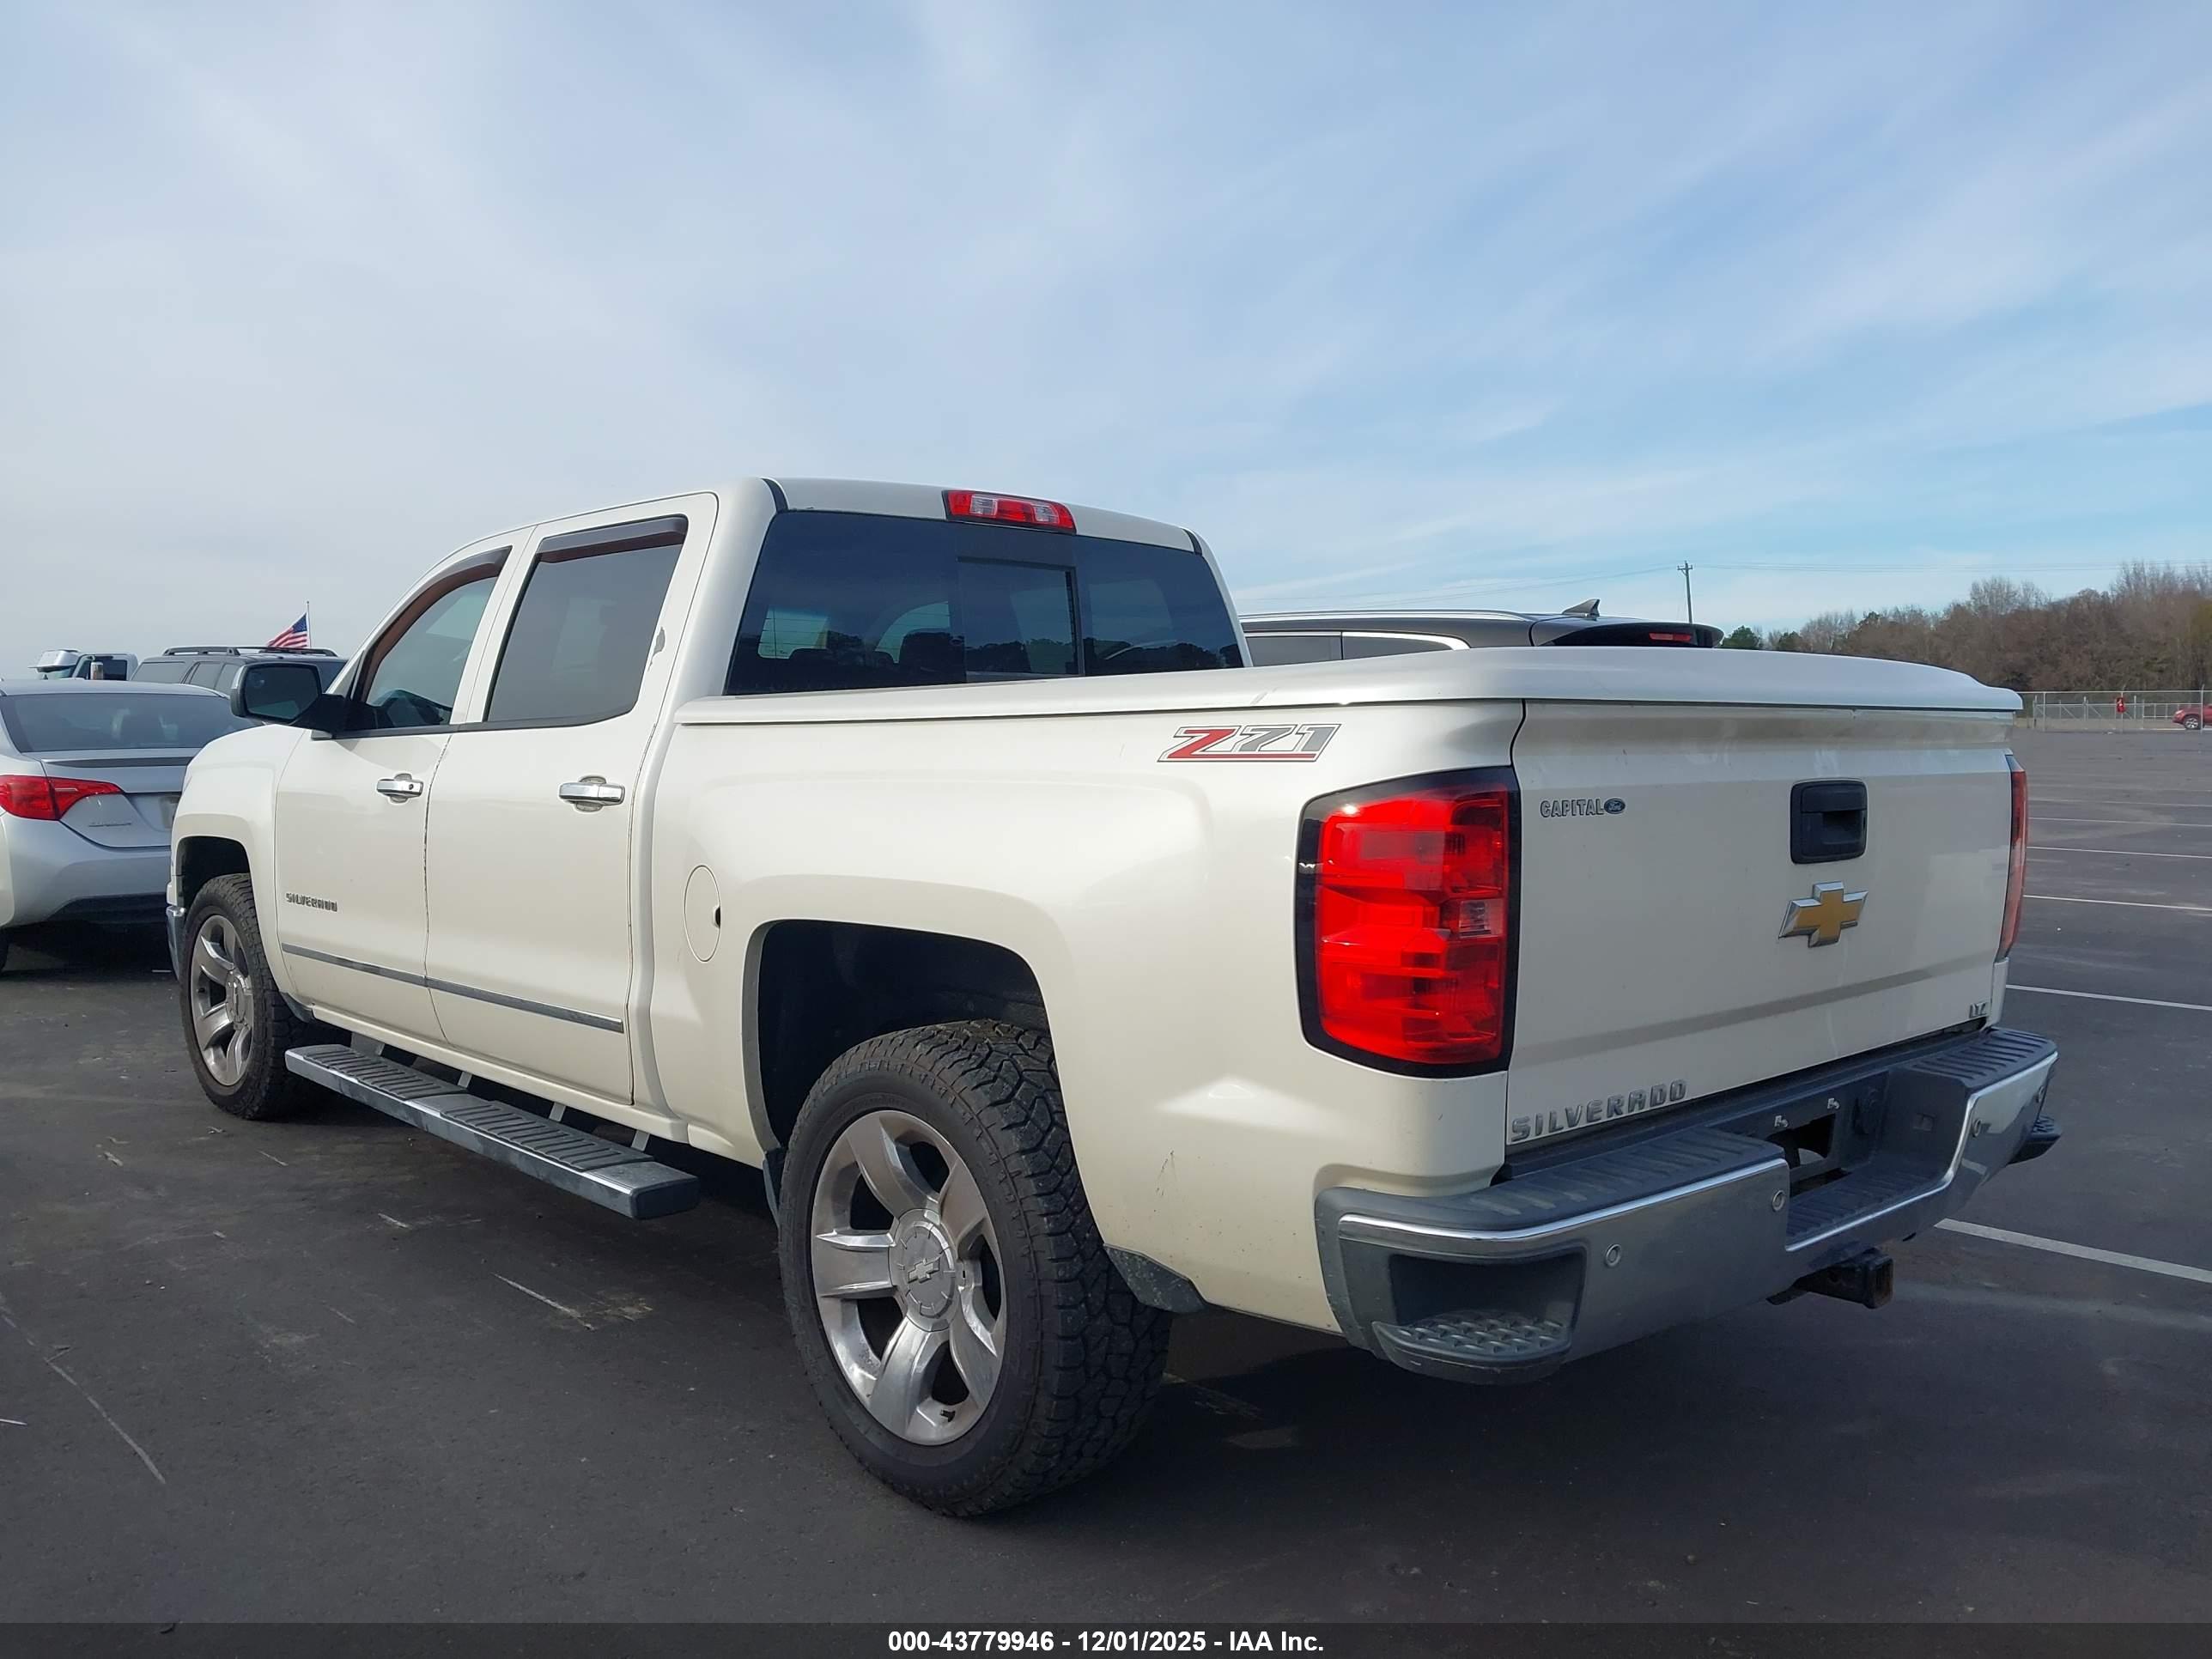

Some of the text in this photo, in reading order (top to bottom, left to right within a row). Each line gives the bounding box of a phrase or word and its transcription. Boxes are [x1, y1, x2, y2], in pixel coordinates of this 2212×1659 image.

[1157, 723, 1342, 763] Z71
[1540, 798, 1604, 817] CAPITAL
[1510, 1079, 1687, 1142] SILVERADO
